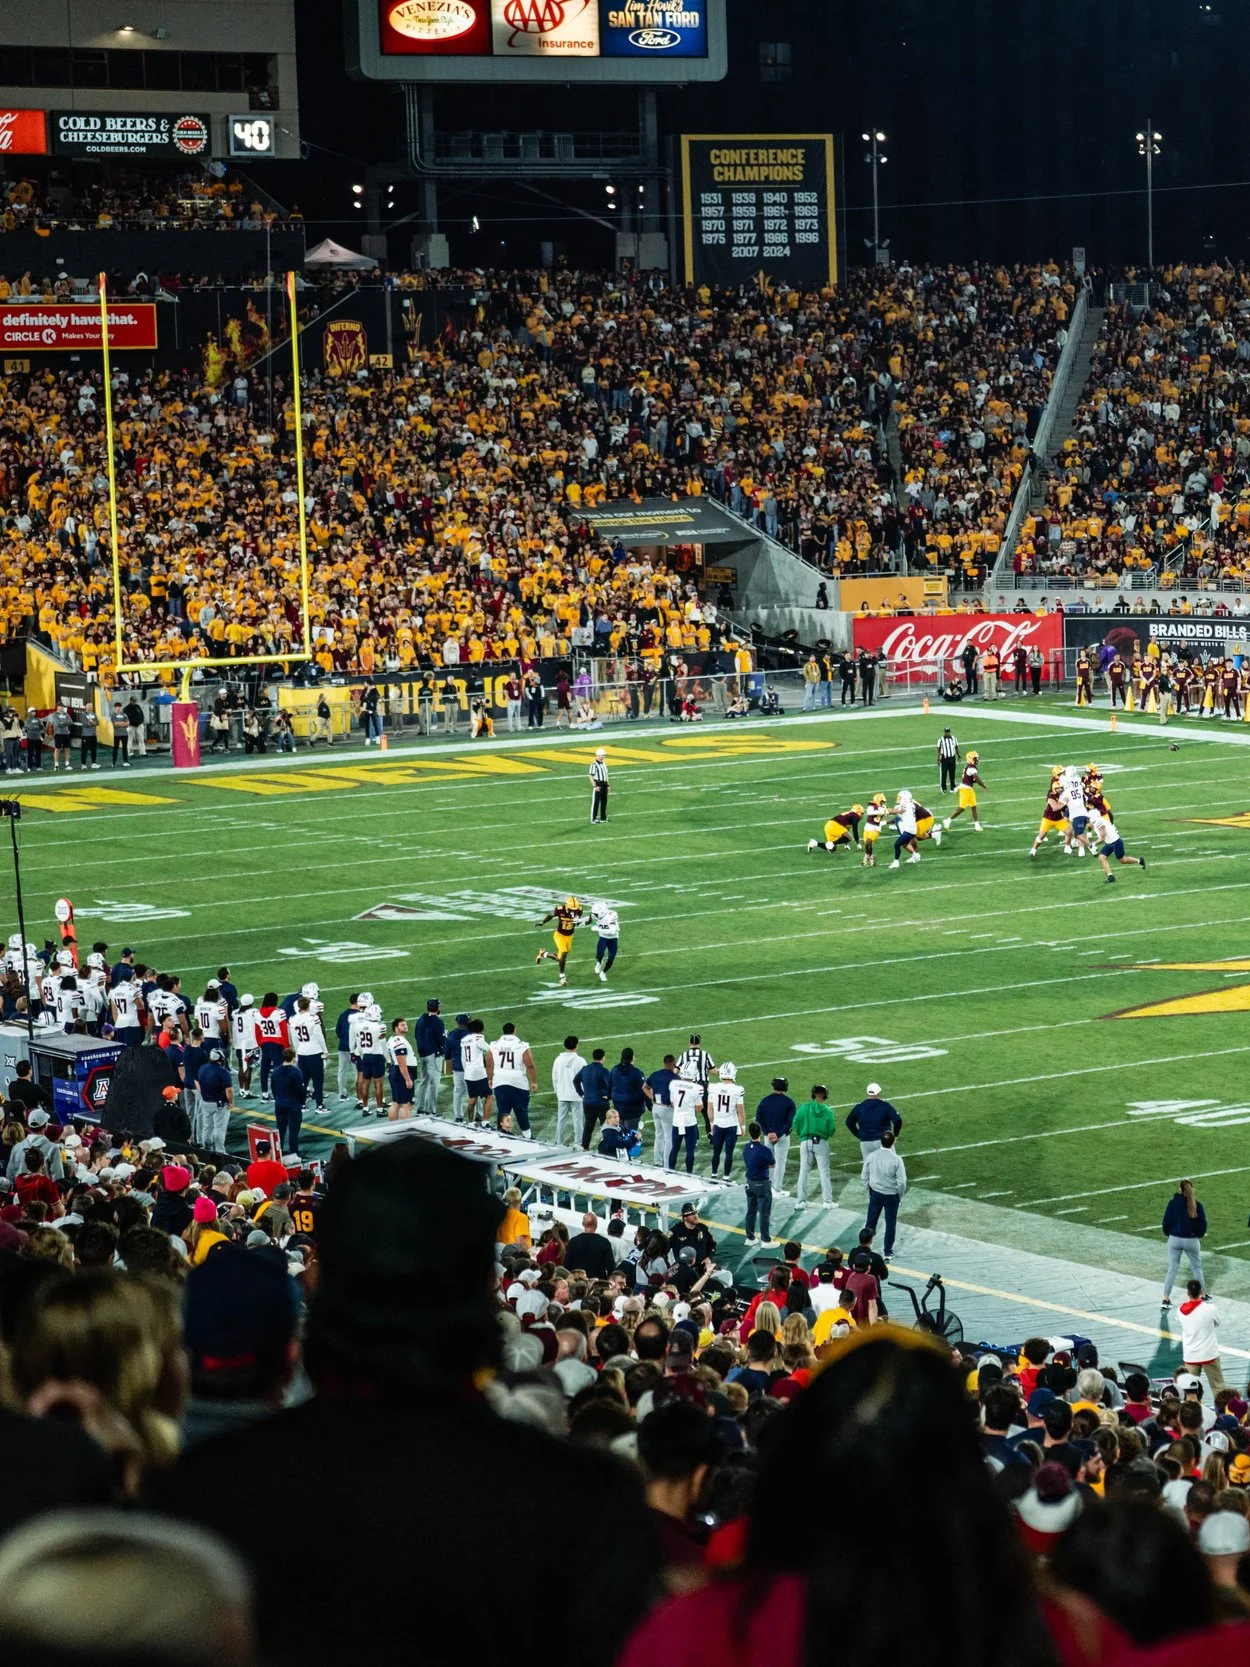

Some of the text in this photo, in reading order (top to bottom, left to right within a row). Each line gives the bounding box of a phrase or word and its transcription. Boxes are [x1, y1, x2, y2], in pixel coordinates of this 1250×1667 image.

[395, 1, 472, 19] VENEZIA'S
[507, 0, 562, 32] AAA
[608, 11, 699, 28] SAN TAN FORD
[538, 37, 594, 48] Insurance
[638, 31, 671, 45] Ford
[59, 116, 170, 132] COLD BEERS &
[59, 131, 169, 144] CHEESEBURGERS
[234, 120, 270, 151] 40
[86, 145, 146, 153] COLDBEERS.COM
[710, 148, 806, 165] CONFERENCE
[713, 166, 804, 182] CHAMPIONS
[700, 192, 722, 204] 1931
[763, 192, 787, 203] 1940
[793, 192, 818, 203] 1952
[701, 206, 725, 218] 1957
[732, 206, 756, 217] 1959
[794, 205, 818, 217] 1969
[701, 219, 819, 231] 1970 1971 1972 1973
[702, 233, 726, 244] 1975
[733, 233, 757, 244] 1977
[795, 232, 819, 244] 1996
[731, 246, 791, 258] 2007 2024
[2, 313, 69, 329] definitely
[71, 315, 102, 326] have
[329, 322, 361, 332] INFERNO
[4, 331, 40, 342] CIRCLE
[44, 331, 55, 343] K
[62, 332, 84, 340] Makes
[11, 360, 24, 372] 41
[375, 356, 388, 367] 42
[592, 516, 631, 527] hange
[1149, 623, 1247, 638] BRANDED BILLS
[1071, 789, 1082, 800] 95
[200, 1012, 210, 1029] 10
[237, 1016, 244, 1033] 9
[261, 1020, 276, 1035] 38
[295, 1025, 310, 1042] 39
[360, 1032, 373, 1048] 29
[789, 1036, 949, 1064] 50
[498, 1051, 515, 1069] 74
[678, 1089, 686, 1108] 7
[717, 1094, 730, 1113] 14
[293, 1210, 314, 1232] 19
